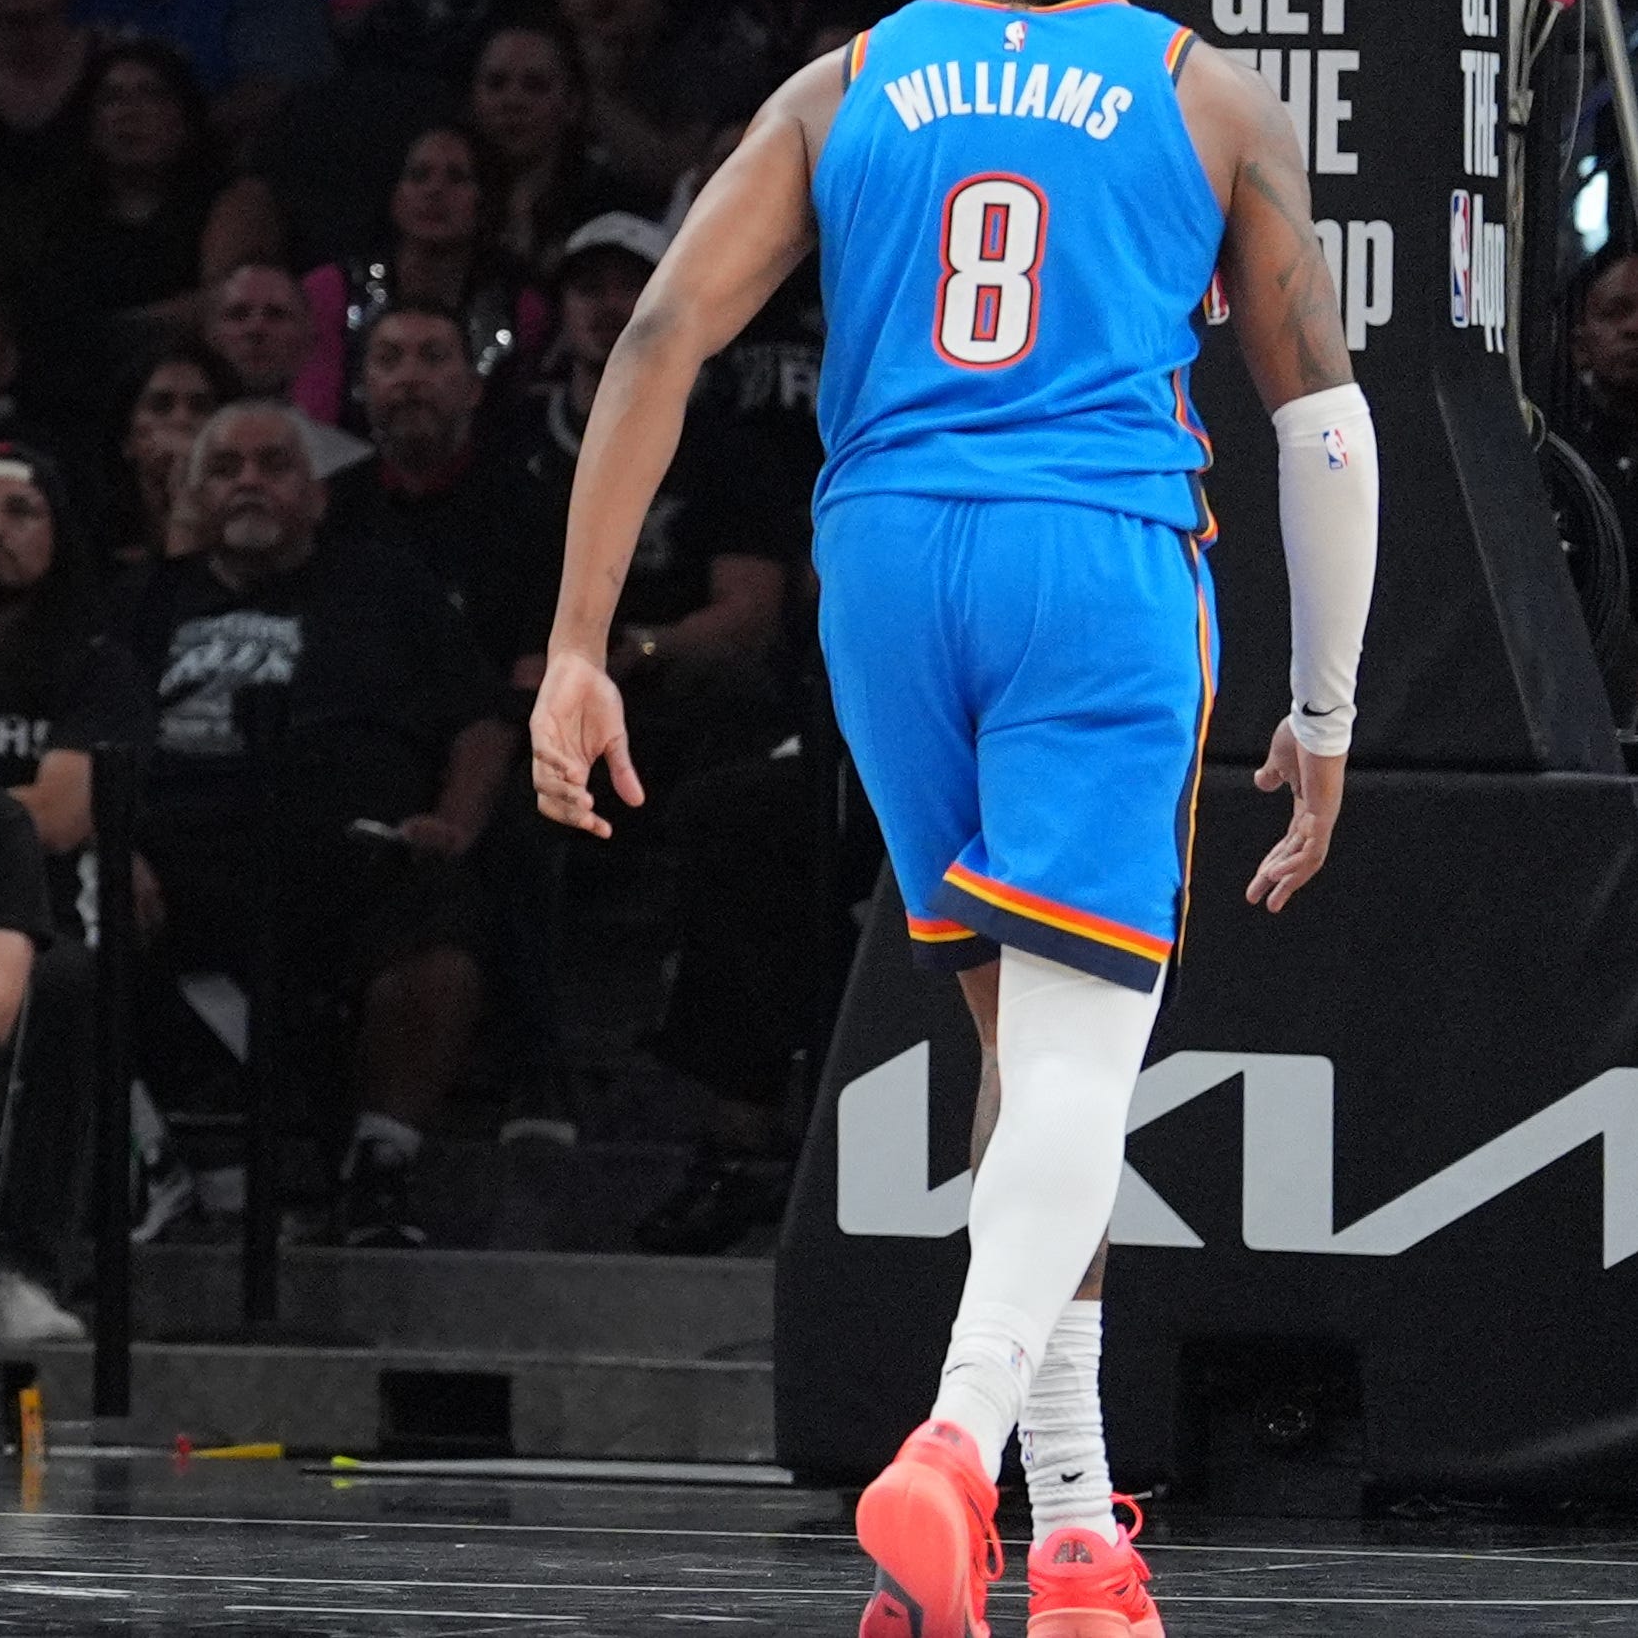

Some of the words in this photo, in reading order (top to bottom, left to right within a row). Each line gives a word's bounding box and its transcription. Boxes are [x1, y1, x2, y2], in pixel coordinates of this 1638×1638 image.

[883, 60, 1134, 140] WILLIAMS
[1224, 48, 1360, 175] HE
[1460, 50, 1500, 177] THE
[932, 172, 1049, 371] 8
[1471, 194, 1506, 354] App
